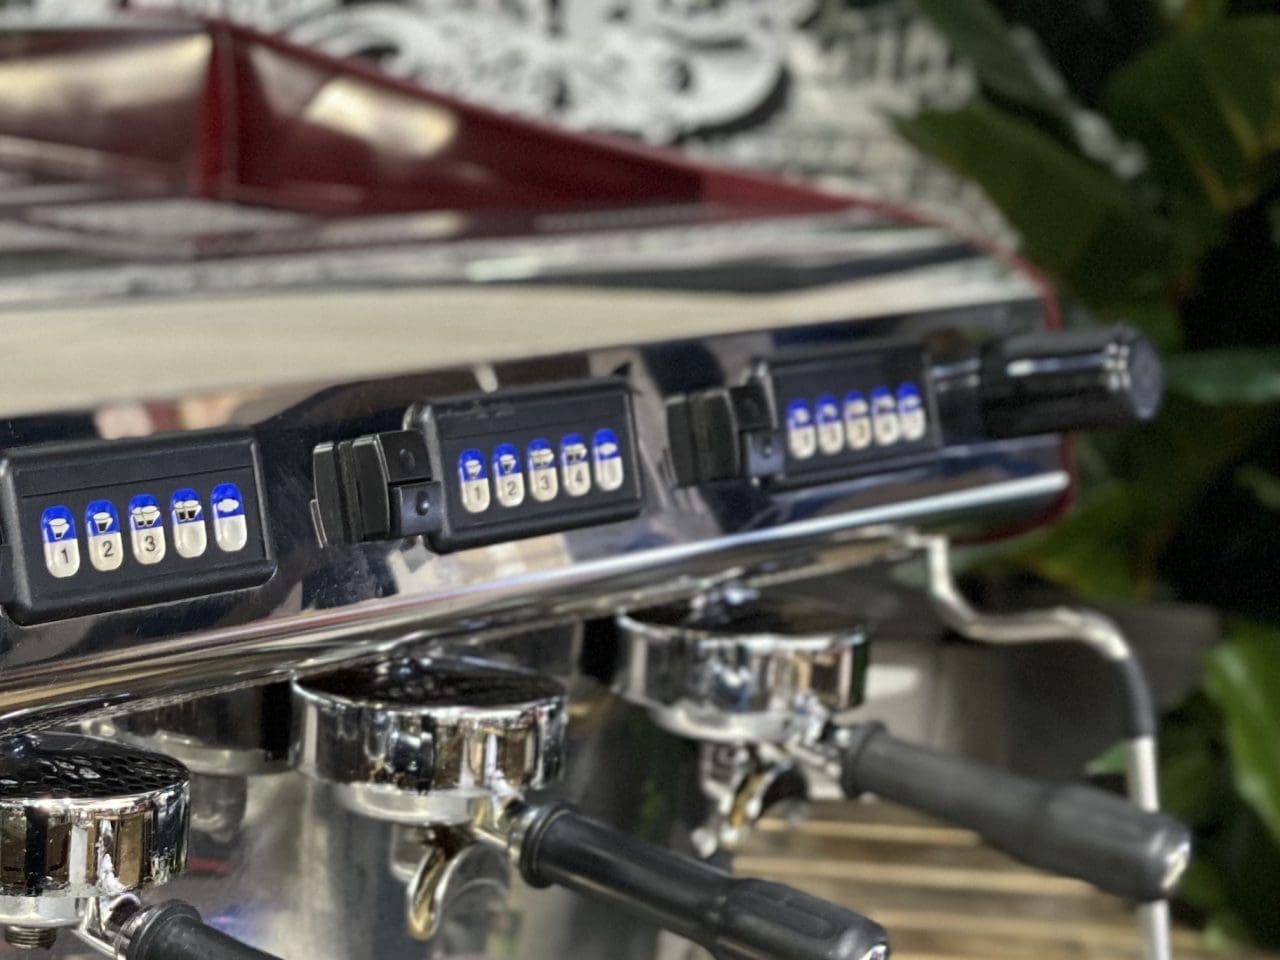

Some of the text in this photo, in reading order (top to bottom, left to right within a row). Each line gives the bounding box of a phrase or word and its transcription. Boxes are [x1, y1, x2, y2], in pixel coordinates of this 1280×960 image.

[474, 470, 584, 501] 1 2 3 4
[60, 536, 156, 564] 1 2 3
